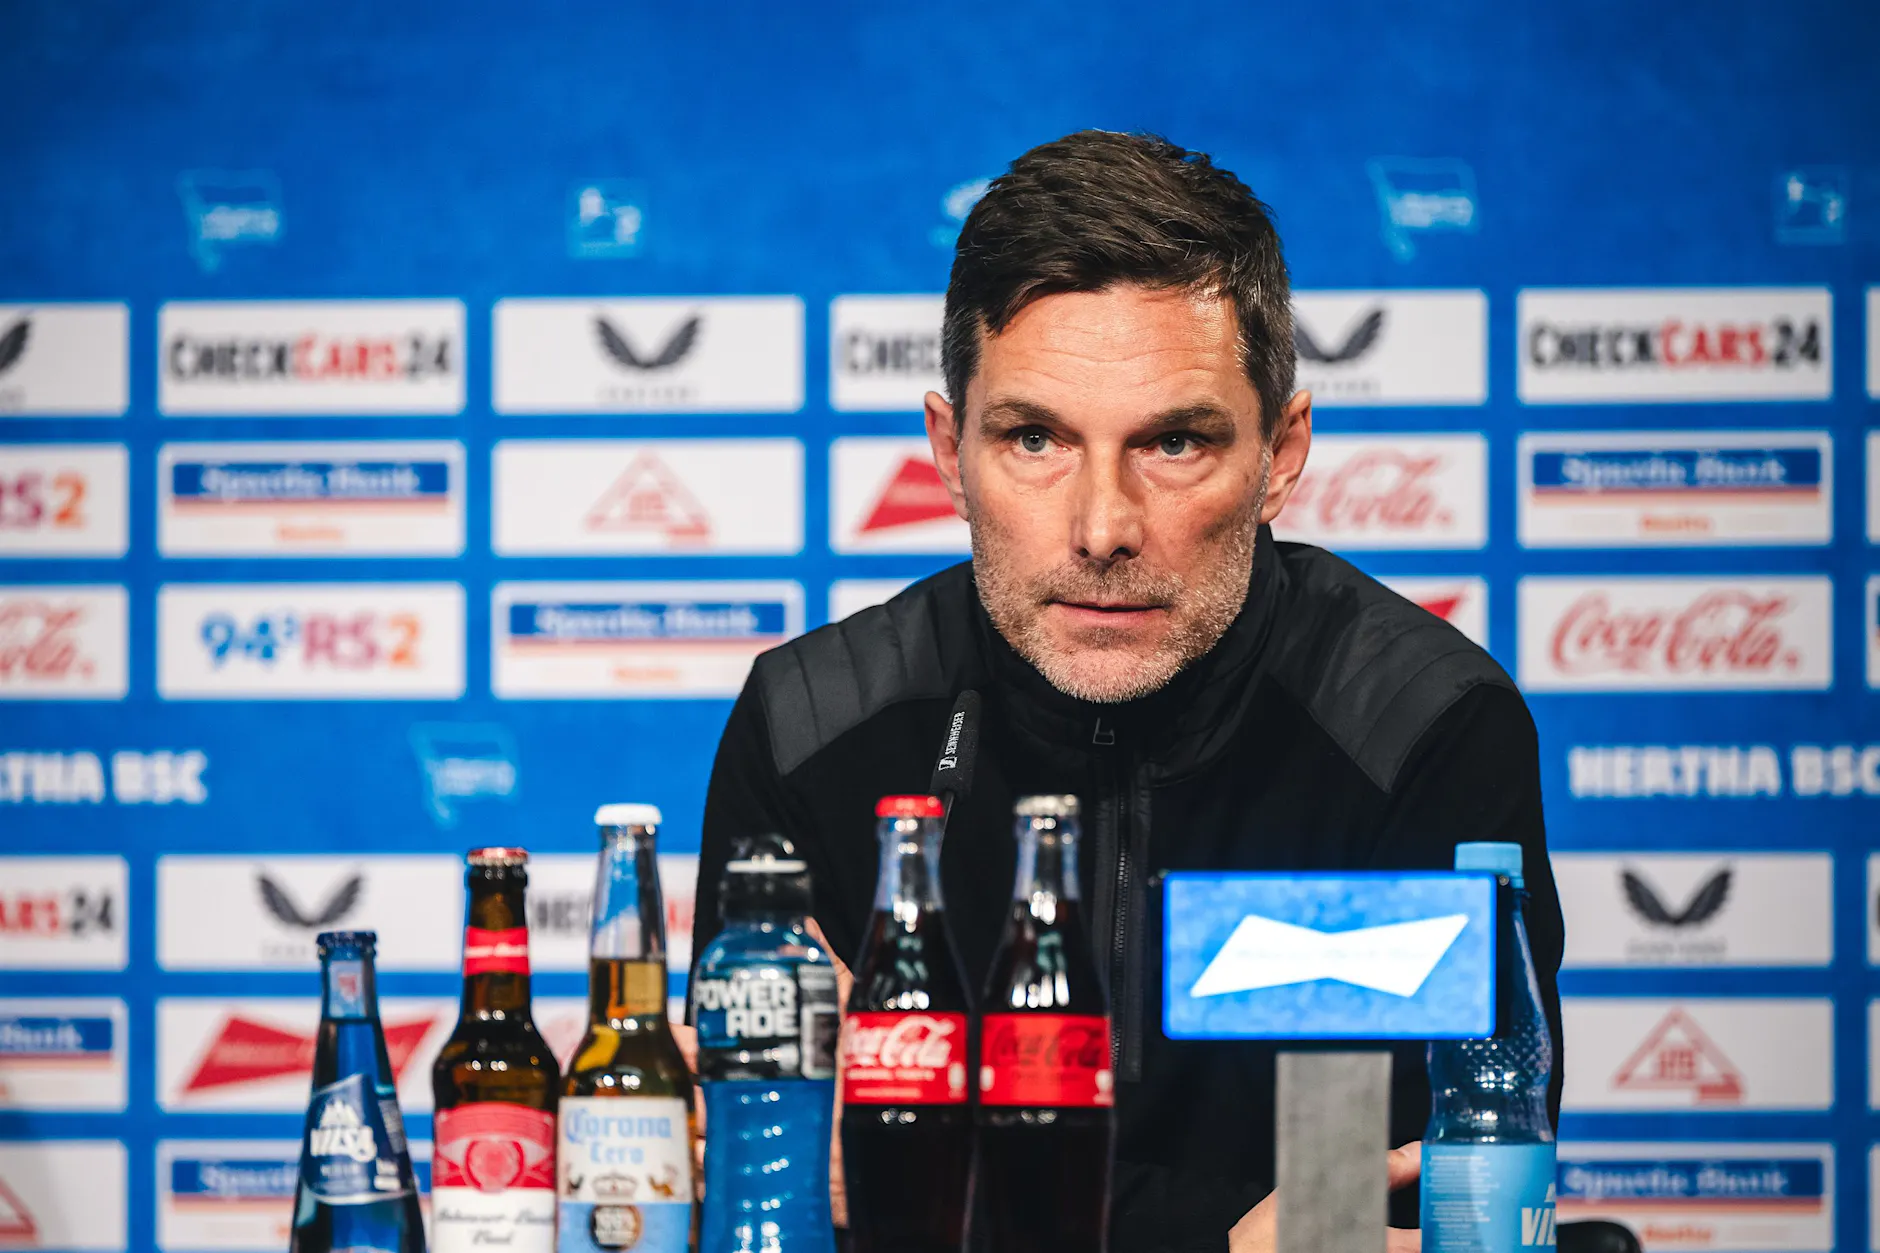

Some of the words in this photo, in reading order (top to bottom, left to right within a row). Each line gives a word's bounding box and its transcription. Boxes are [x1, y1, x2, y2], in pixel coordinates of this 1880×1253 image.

[1530, 319, 1824, 371] CHECKCARS24
[1569, 746, 1781, 797] HERTHA
[566, 1108, 673, 1144] Corona
